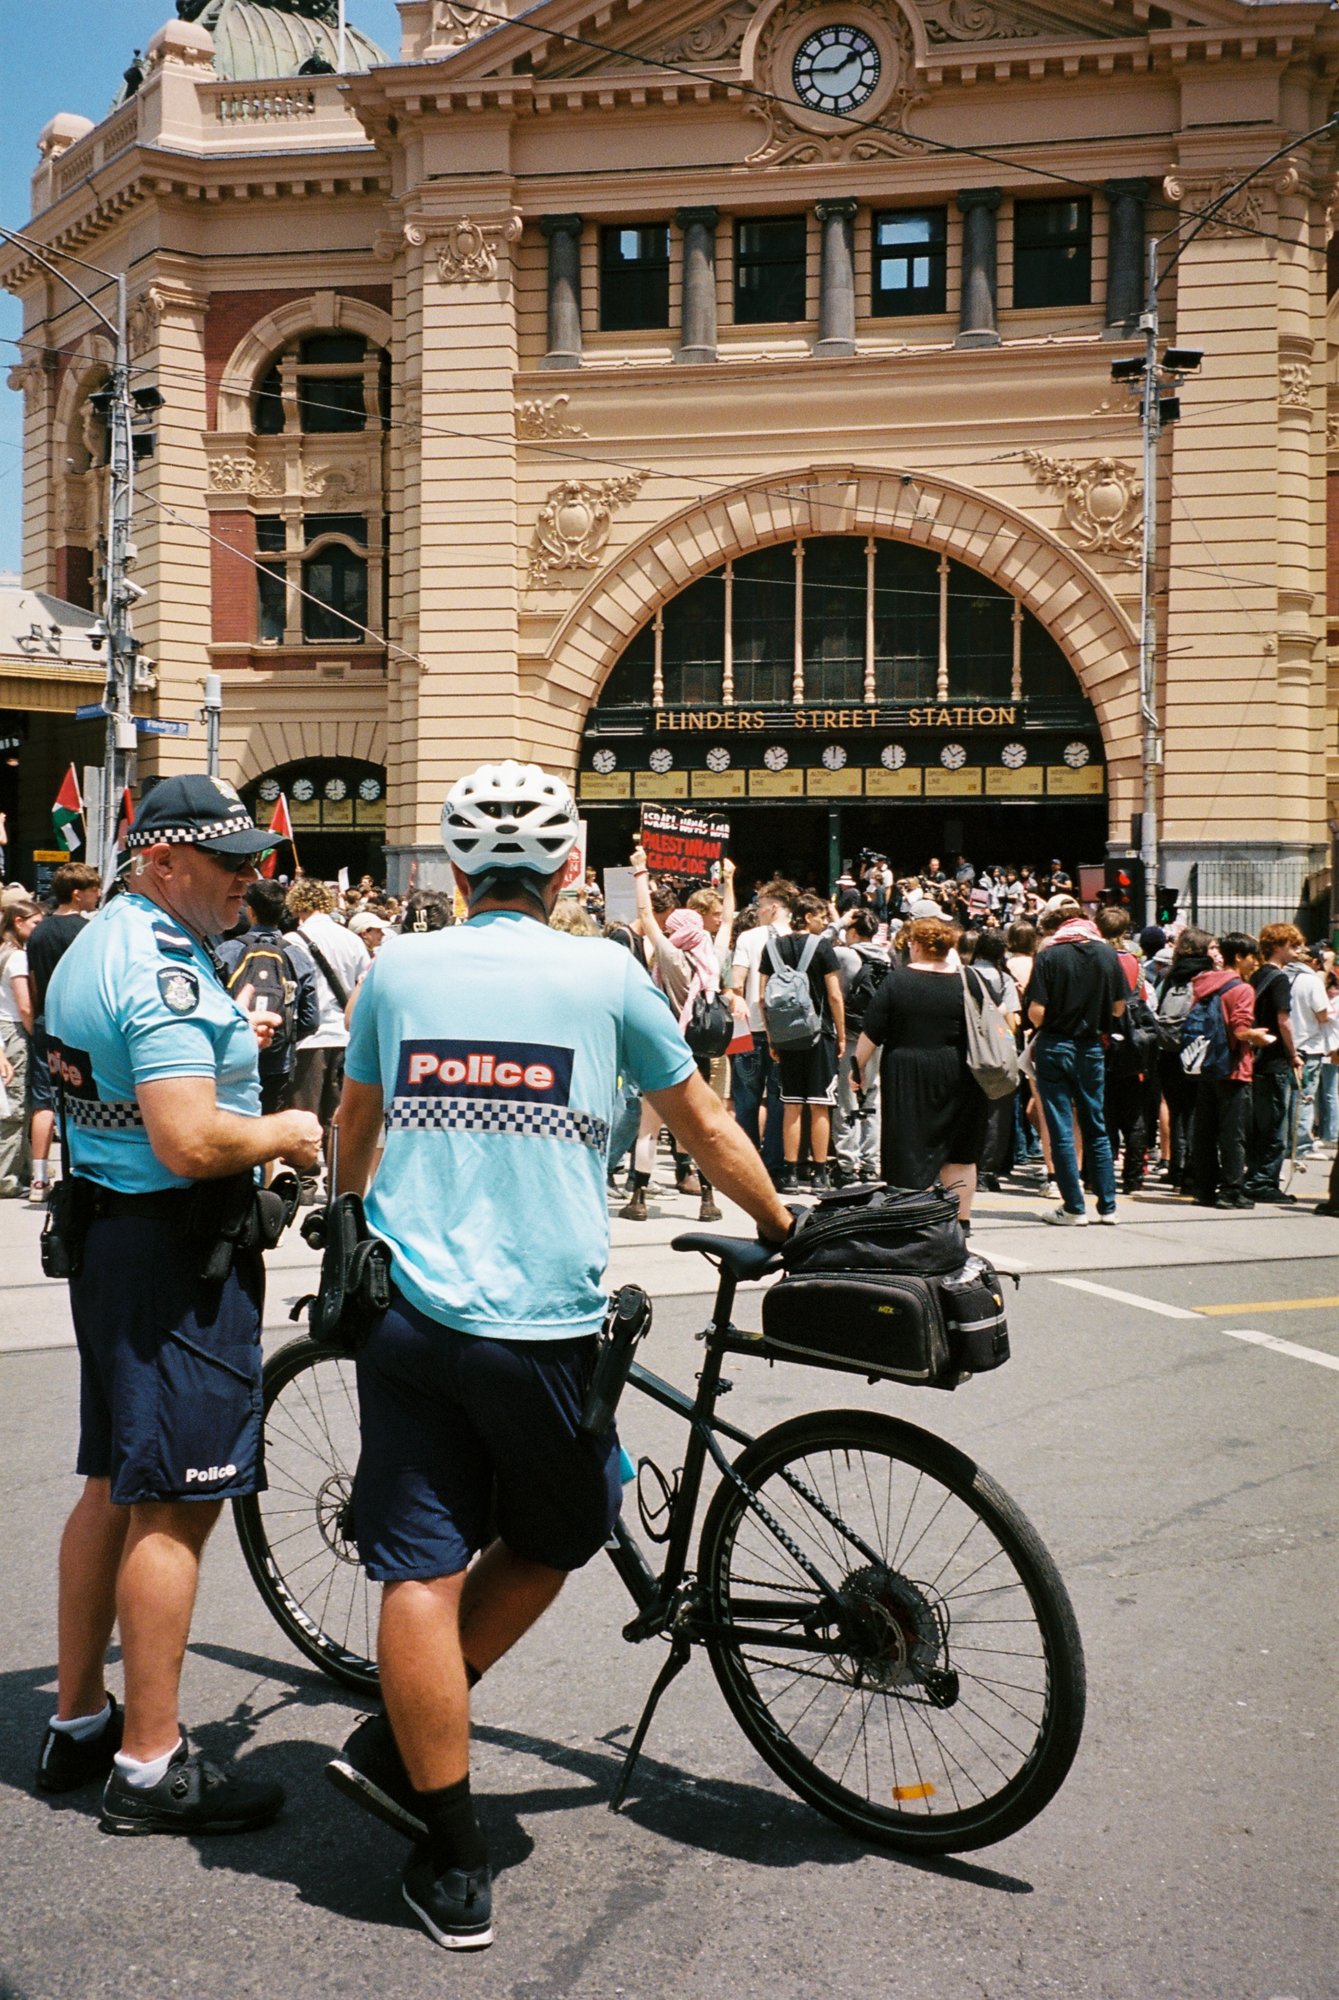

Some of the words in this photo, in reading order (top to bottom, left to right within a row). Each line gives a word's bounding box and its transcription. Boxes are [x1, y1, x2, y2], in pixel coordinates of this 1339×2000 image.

[655, 710, 765, 730] FLINDERS
[794, 708, 880, 729] STREET
[907, 706, 1016, 726] STATION
[642, 829, 722, 860] PALESTINIAN
[647, 851, 708, 876] GENOCIDE
[408, 1051, 555, 1091] Police
[185, 1463, 238, 1483] Police
